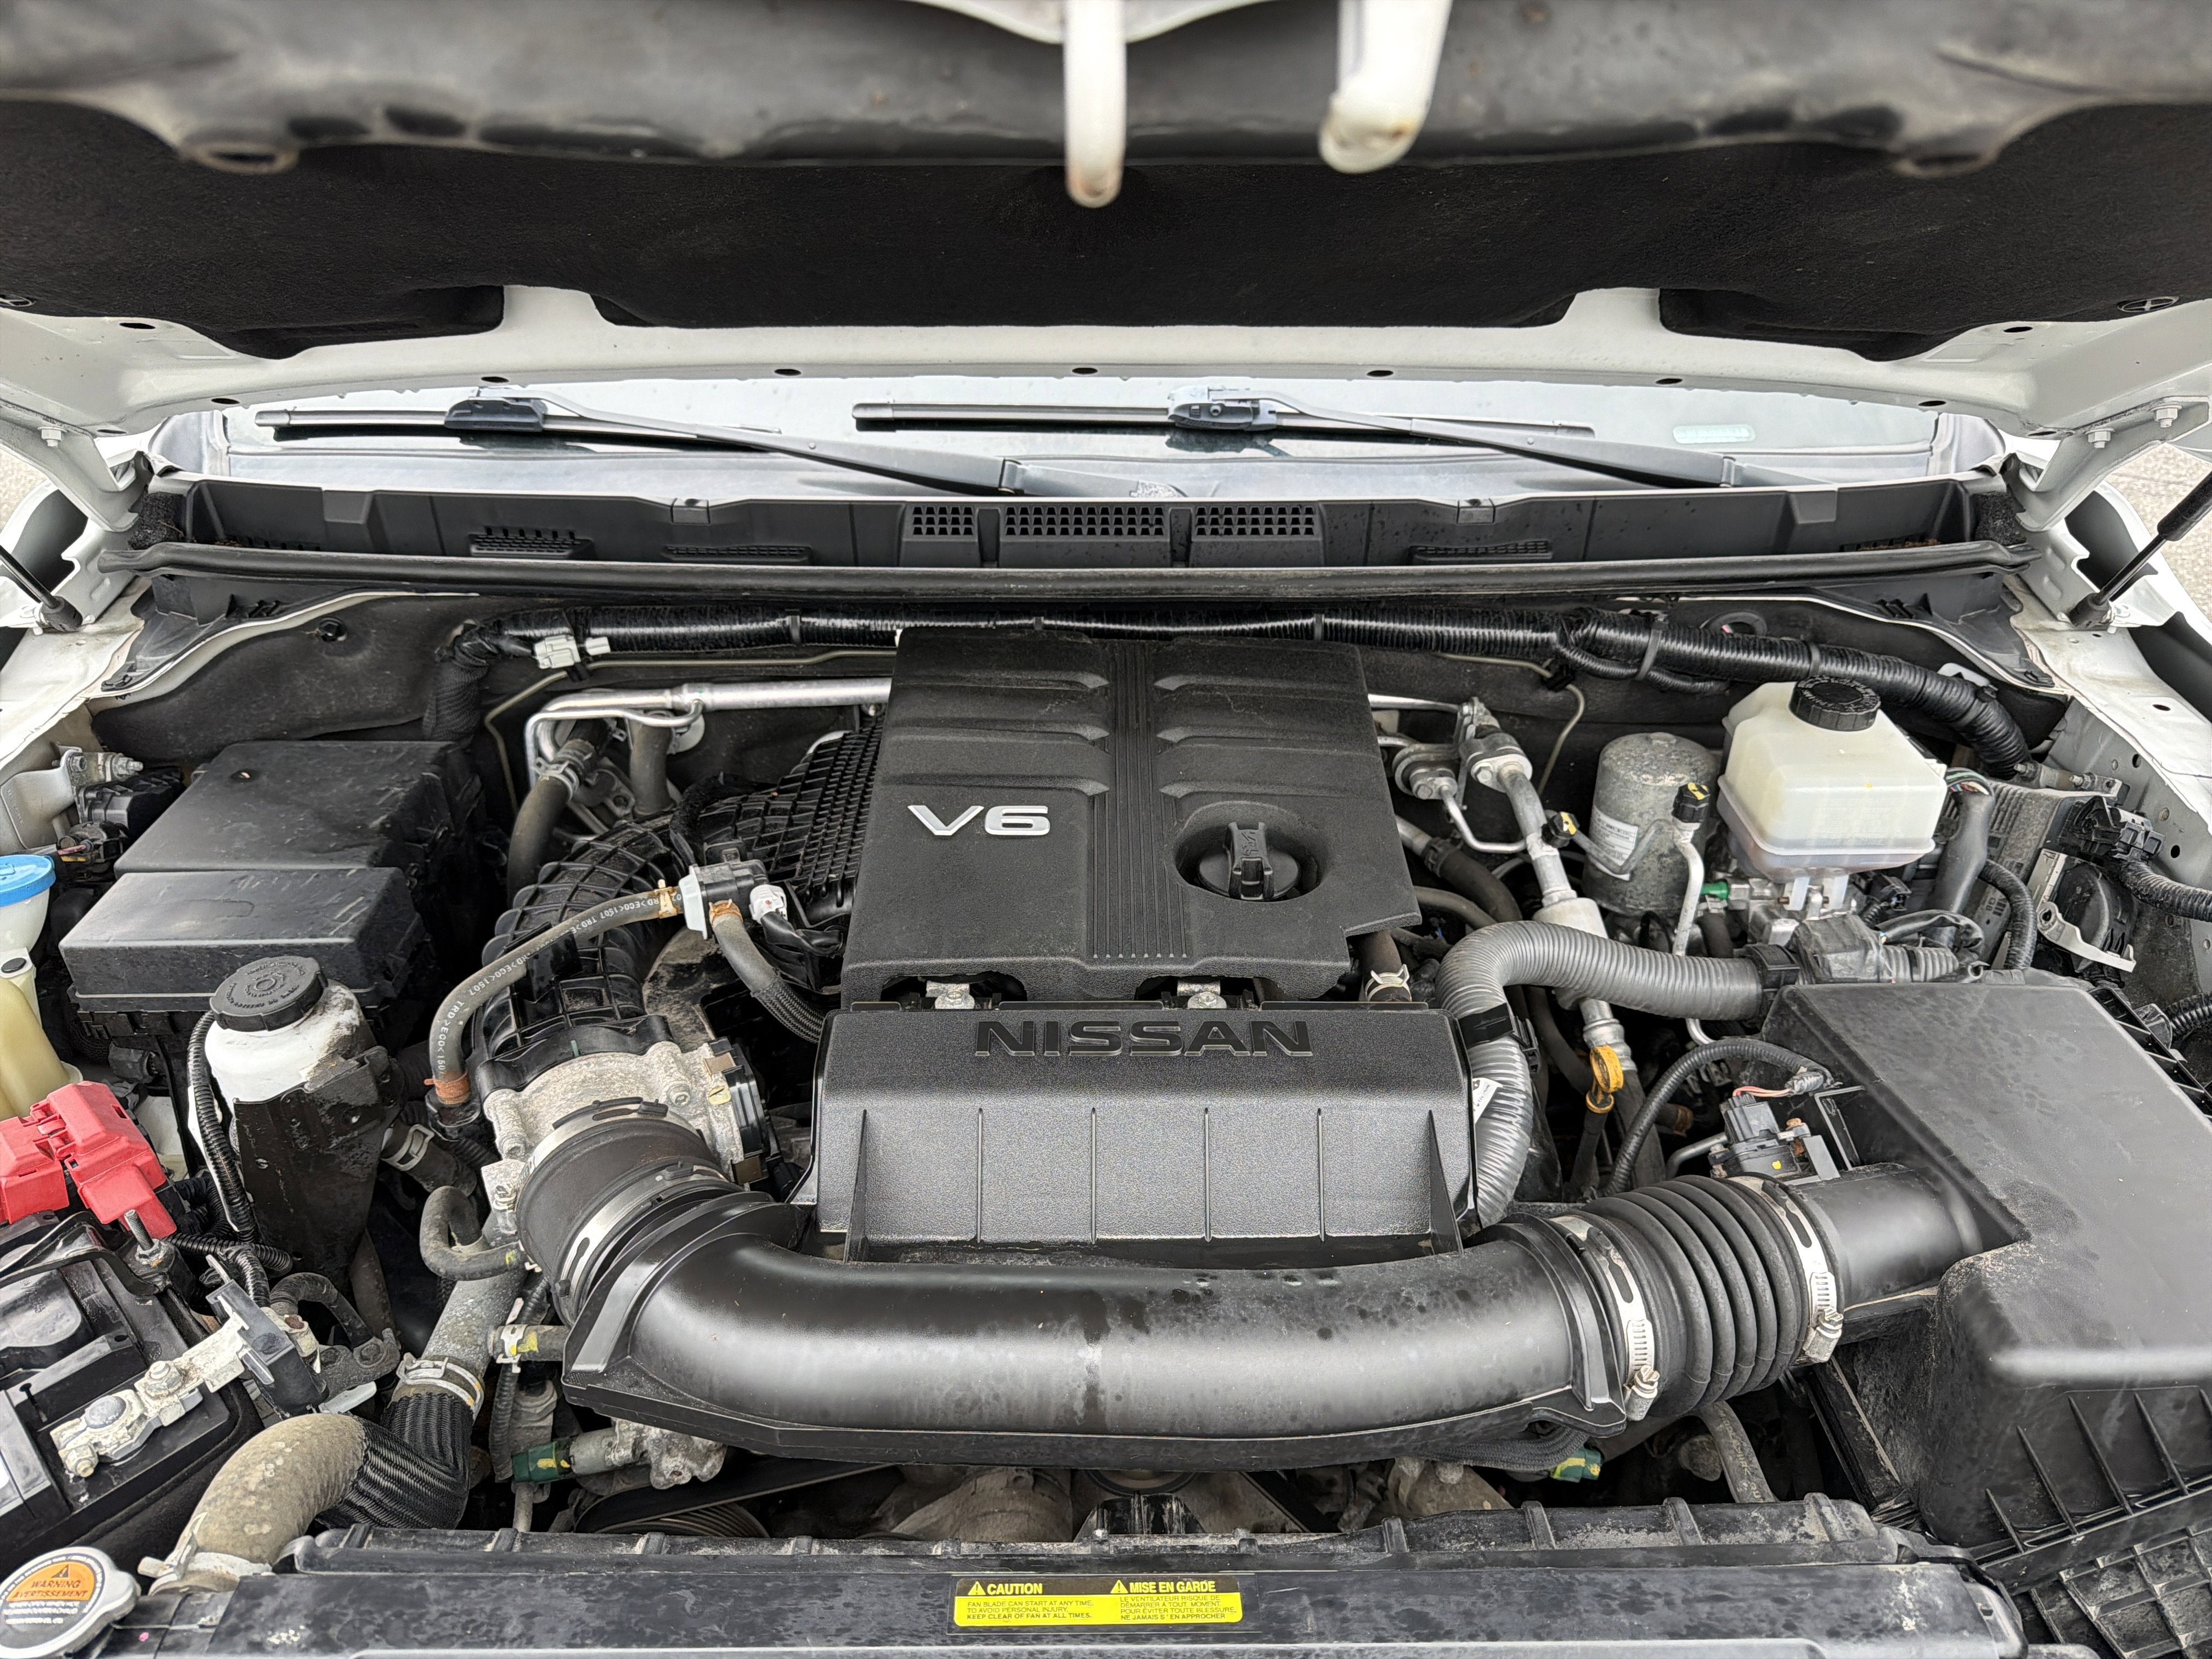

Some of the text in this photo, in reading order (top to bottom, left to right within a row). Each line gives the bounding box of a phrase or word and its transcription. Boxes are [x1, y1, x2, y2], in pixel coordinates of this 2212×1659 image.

[907, 805, 1050, 836] V6
[975, 1020, 1313, 1056] NISSAN
[31, 1579, 81, 1588] WARNING
[988, 1583, 1042, 1595] CAUTION
[1130, 1581, 1216, 1593] MISE EN GARDE
[13, 1590, 88, 1598] AVERTISSEMENT
